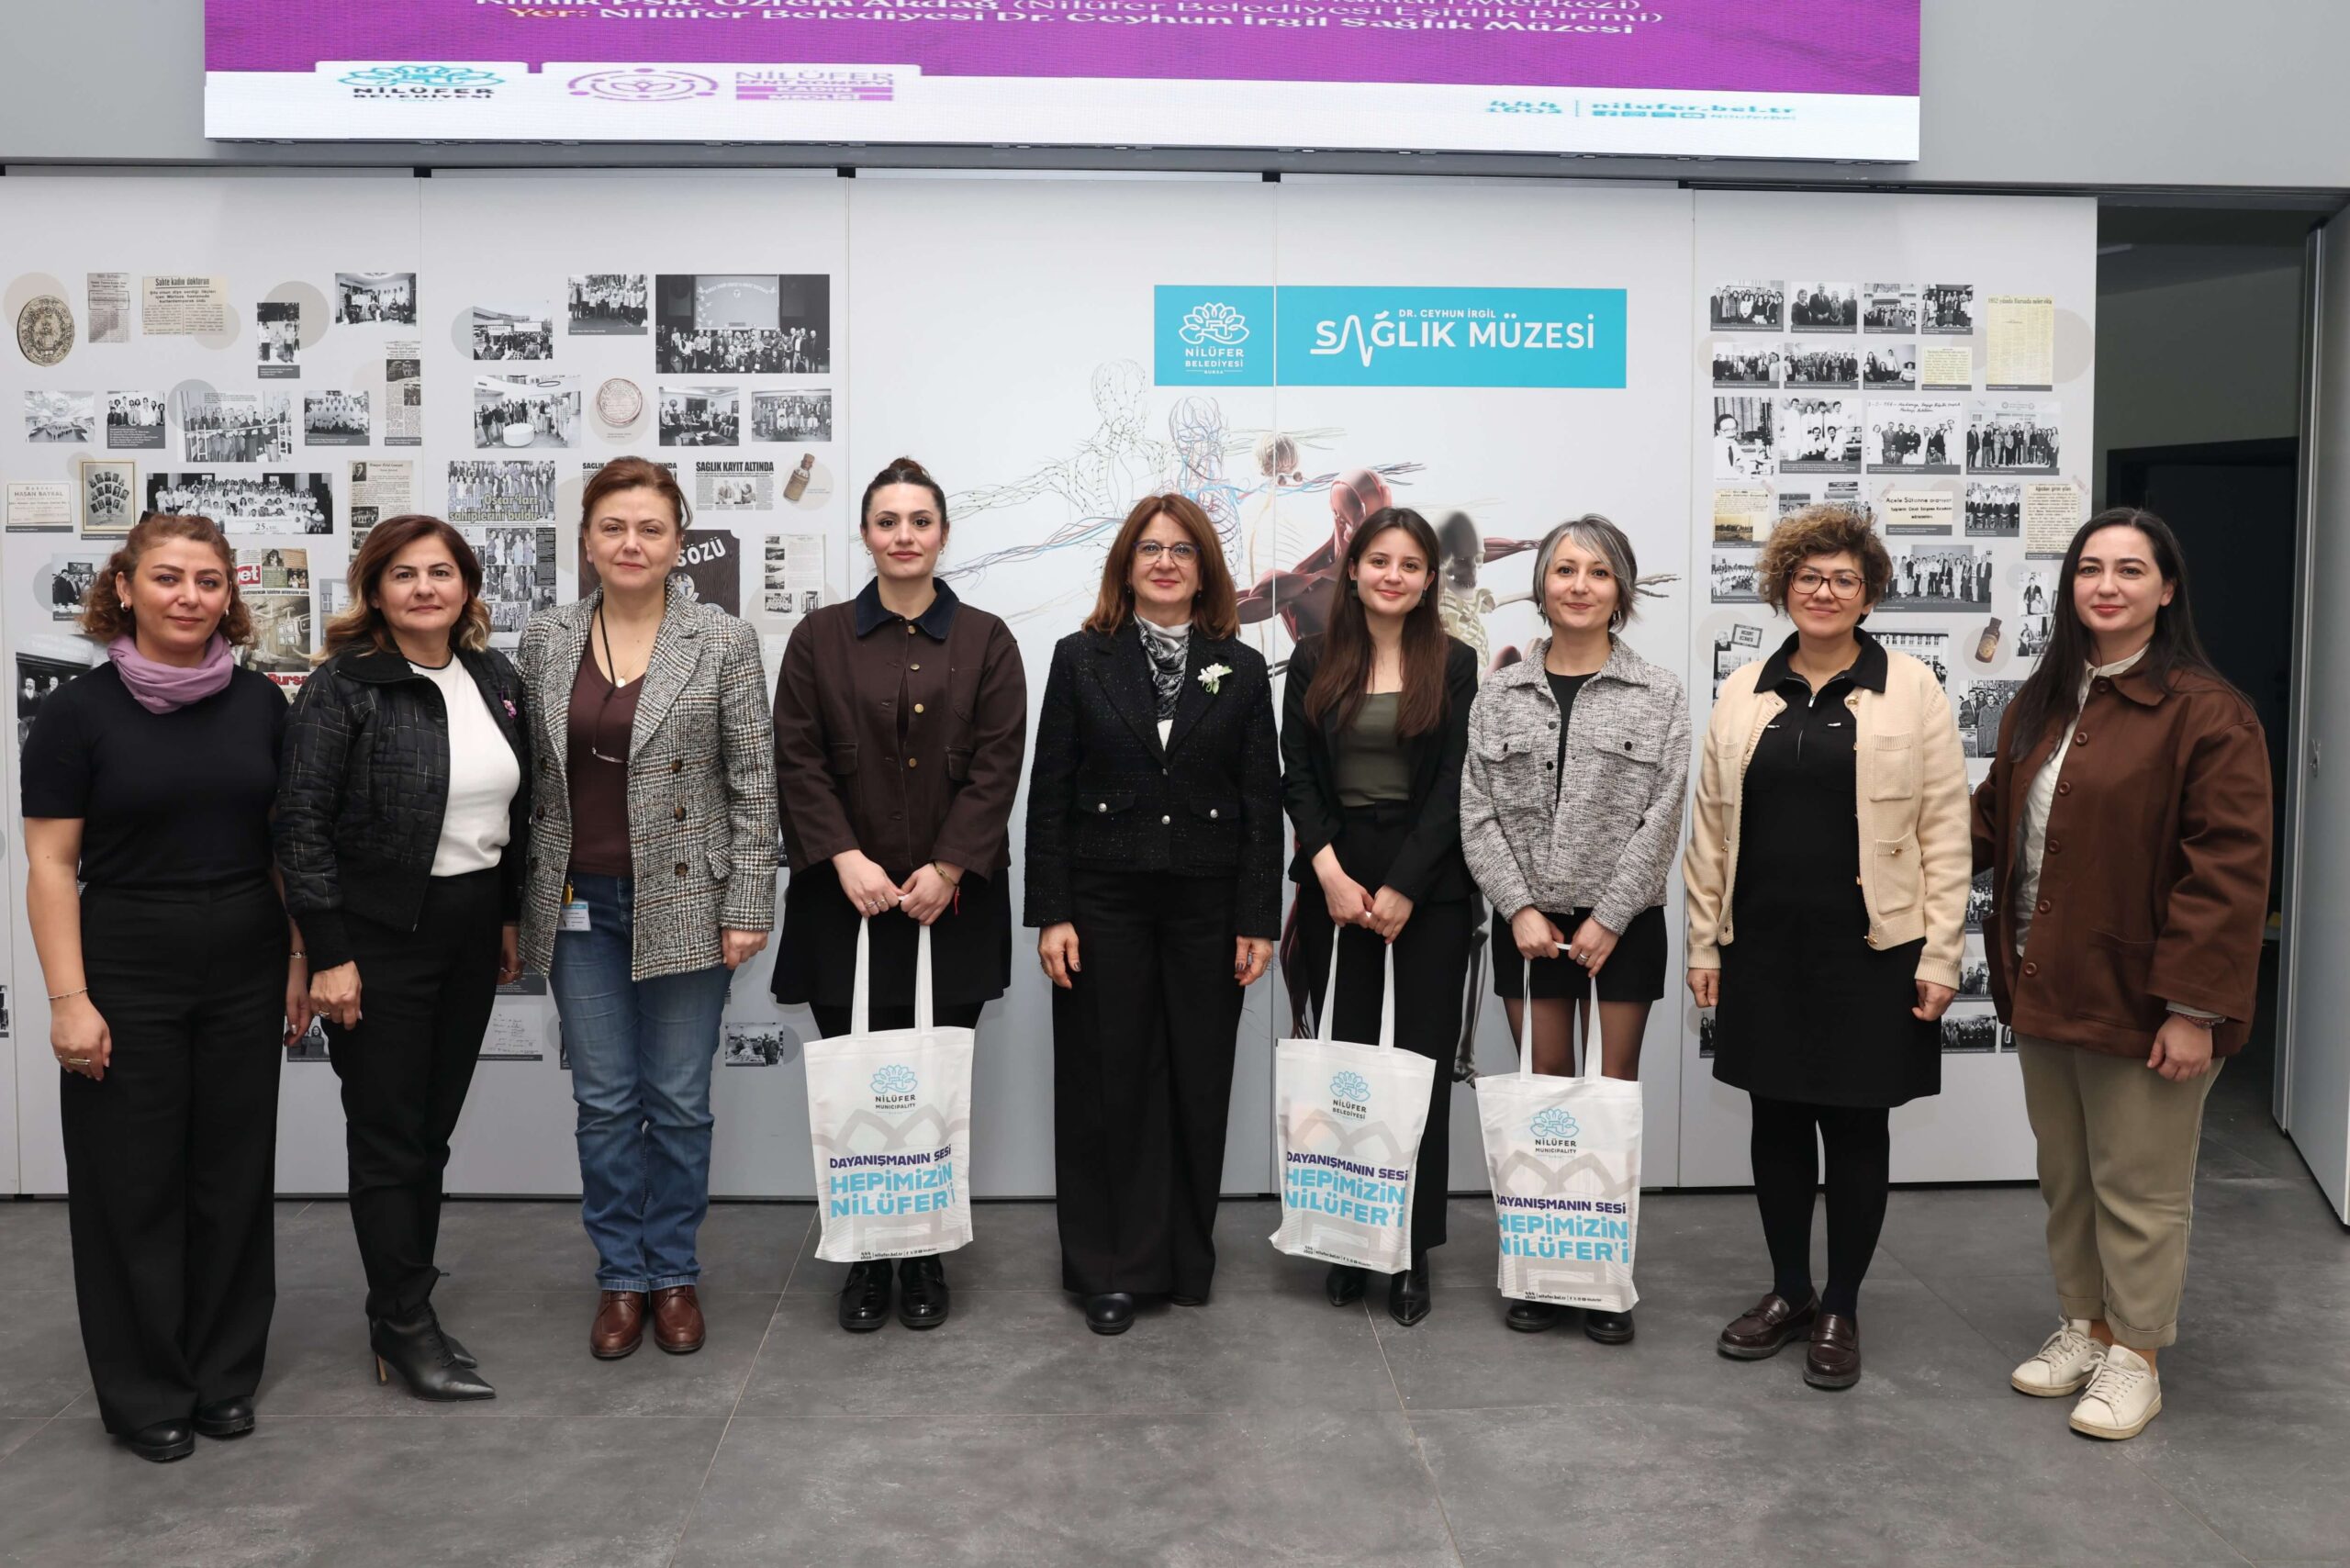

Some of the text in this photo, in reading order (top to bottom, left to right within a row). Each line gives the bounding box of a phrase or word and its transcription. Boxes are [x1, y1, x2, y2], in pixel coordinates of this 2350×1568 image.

[1177, 2, 1381, 15] Belediyesi
[1395, 6, 1517, 18] Eşitlik
[1528, 9, 1663, 22] Birimi)
[507, 8, 1632, 34] Yer: Nilüfer Belediyesi Dr. Ceyhun İrgil Sağlık Müzesi
[735, 71, 893, 81] NİLÜFER
[1592, 102, 1794, 113] nilufer.bel.tr
[1397, 308, 1497, 319] DR. CEYHUN İRGİL
[1310, 310, 1595, 367] SAĞLIK MÜZESİ
[1184, 346, 1245, 357] NİLÜFER
[1184, 359, 1244, 367] BELEDİYESİ
[722, 462, 743, 472] KAYIT
[744, 462, 774, 472] ALTINDA
[875, 1093, 916, 1103] NİLÜFER
[1333, 1099, 1367, 1114] NİLÜFER
[1332, 1107, 1366, 1120] BELEDİYESİ
[1535, 1138, 1577, 1147] NİLÜFER
[830, 1143, 952, 1169] DAYANIŞMANIN SESİ
[1286, 1150, 1409, 1182] DAYANIŞMANIN SESİ
[830, 1161, 953, 1195] HEPİMİZİN
[1285, 1166, 1405, 1205] HEPİMİZİN
[1595, 1202, 1628, 1215] SESİ
[1497, 1212, 1629, 1240] HEPİMİZİN
